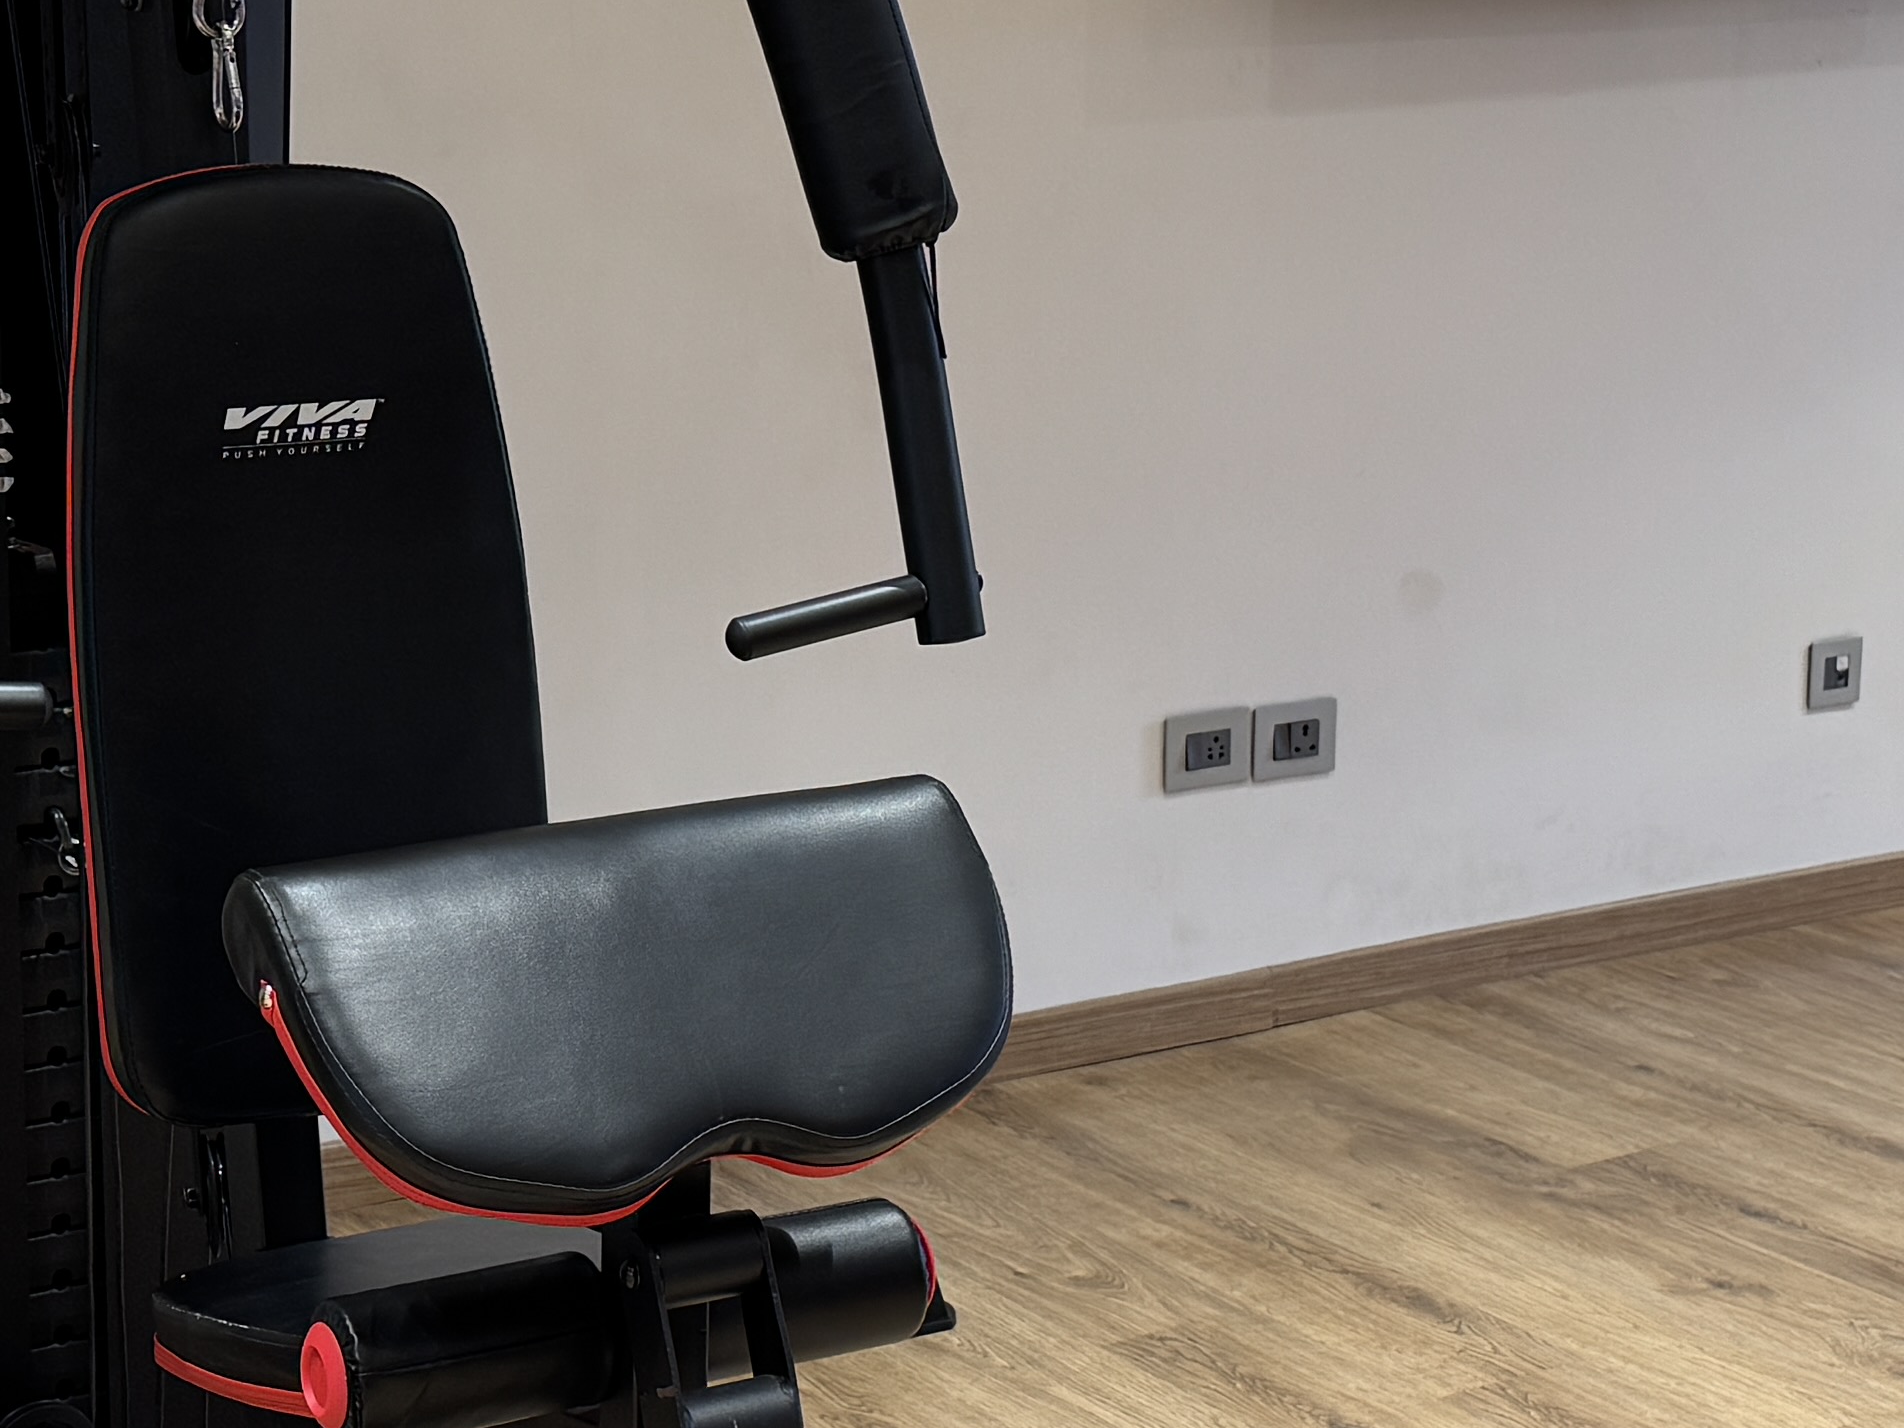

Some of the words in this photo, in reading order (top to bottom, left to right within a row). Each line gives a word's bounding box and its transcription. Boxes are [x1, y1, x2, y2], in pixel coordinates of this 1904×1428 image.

[223, 398, 377, 431] VIVA
[255, 422, 369, 445] FITNESS
[222, 449, 267, 460] PUSH
[275, 441, 367, 456] YOURSELF
